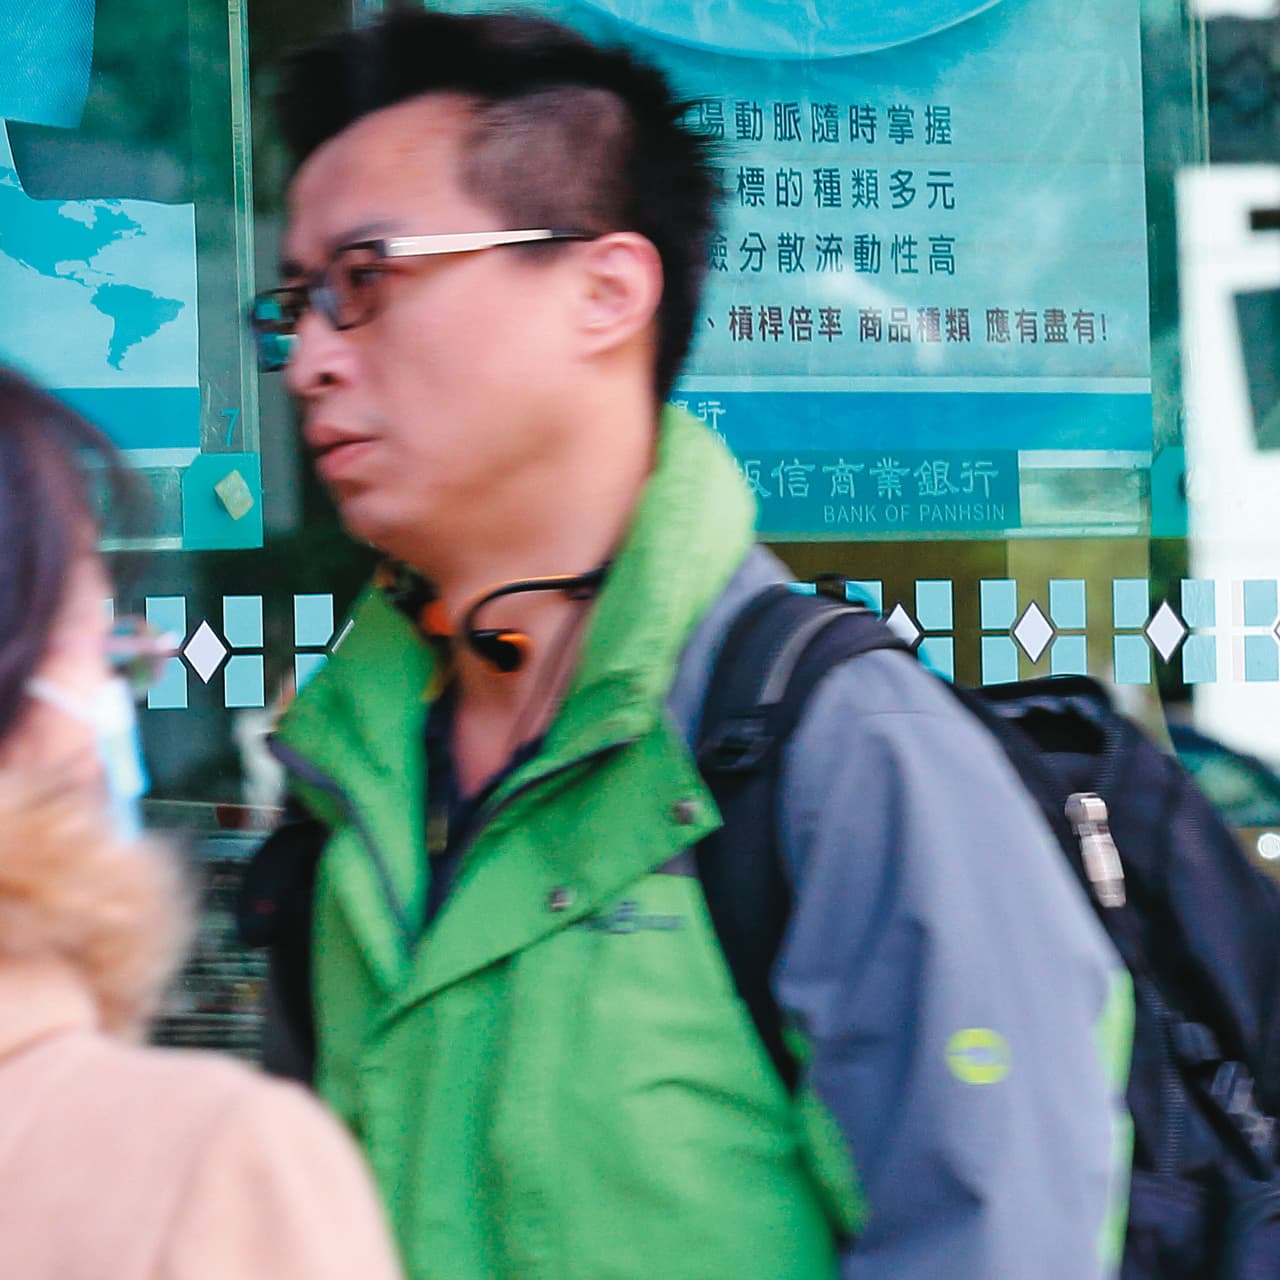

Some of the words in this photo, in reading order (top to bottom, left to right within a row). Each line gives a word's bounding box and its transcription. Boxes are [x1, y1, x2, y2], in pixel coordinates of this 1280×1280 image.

[714, 165, 956, 210] 標的種類多元
[858, 306, 971, 344] 商品種類
[823, 505, 877, 523] BANK
[885, 505, 911, 522] OF
[920, 503, 1006, 522] PANHSIN
